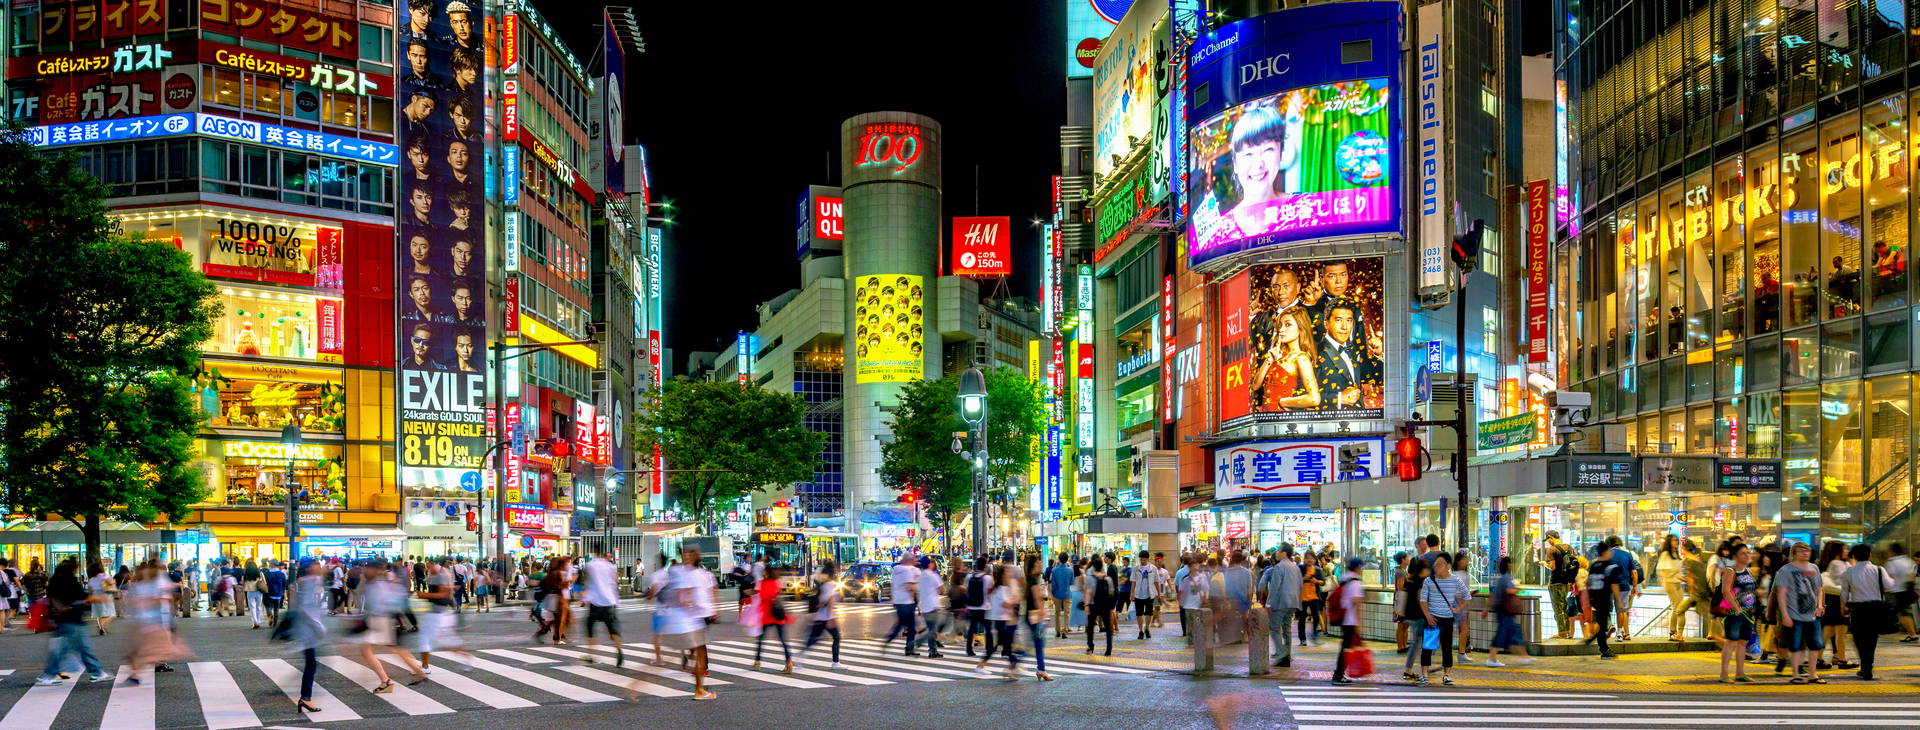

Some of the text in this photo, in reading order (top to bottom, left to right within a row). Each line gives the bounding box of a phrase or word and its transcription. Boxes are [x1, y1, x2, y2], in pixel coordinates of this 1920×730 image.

[202, 0, 355, 49] コンタクト
[112, 44, 174, 73] ガスト
[1076, 48, 1101, 58] Mast
[1191, 32, 1240, 67] DHC Channel
[308, 64, 379, 96] ガスト
[1240, 52, 1291, 86] DHC
[12, 96, 39, 118] 7F
[46, 93, 77, 110] Café
[81, 83, 154, 119] ガスト
[168, 119, 184, 131] 6F
[202, 117, 256, 139] AEON
[506, 105, 516, 134] ガスト
[866, 124, 920, 134] SHIBUYA
[1421, 33, 1440, 216] Taisei neon
[52, 120, 160, 143] 英会話イーオン
[265, 127, 395, 160] 英会話イーオン
[855, 133, 923, 173] 109
[217, 218, 301, 248] 1000%
[964, 223, 999, 246] H&M
[1257, 234, 1275, 245] DHC
[977, 251, 996, 259] この先
[1422, 256, 1442, 266] 3719
[1423, 247, 1440, 257] (03)
[650, 233, 660, 299] BIC CAMERA
[977, 259, 1003, 269] 150m
[1422, 265, 1442, 275] 2468
[1530, 184, 1547, 354] クスリのことなら 三千里
[1226, 307, 1243, 338] No.1
[1117, 350, 1151, 378] Euphoria
[1225, 362, 1244, 390] FX
[403, 369, 485, 414] EXILE
[403, 410, 485, 423] 24karats GOLD SOUL
[403, 421, 485, 438] NEW SINGLE
[404, 435, 453, 467] 8.19
[453, 446, 469, 457] ON
[261, 459, 308, 467] PROVECE
[1578, 472, 1611, 485] 渋谷駅
